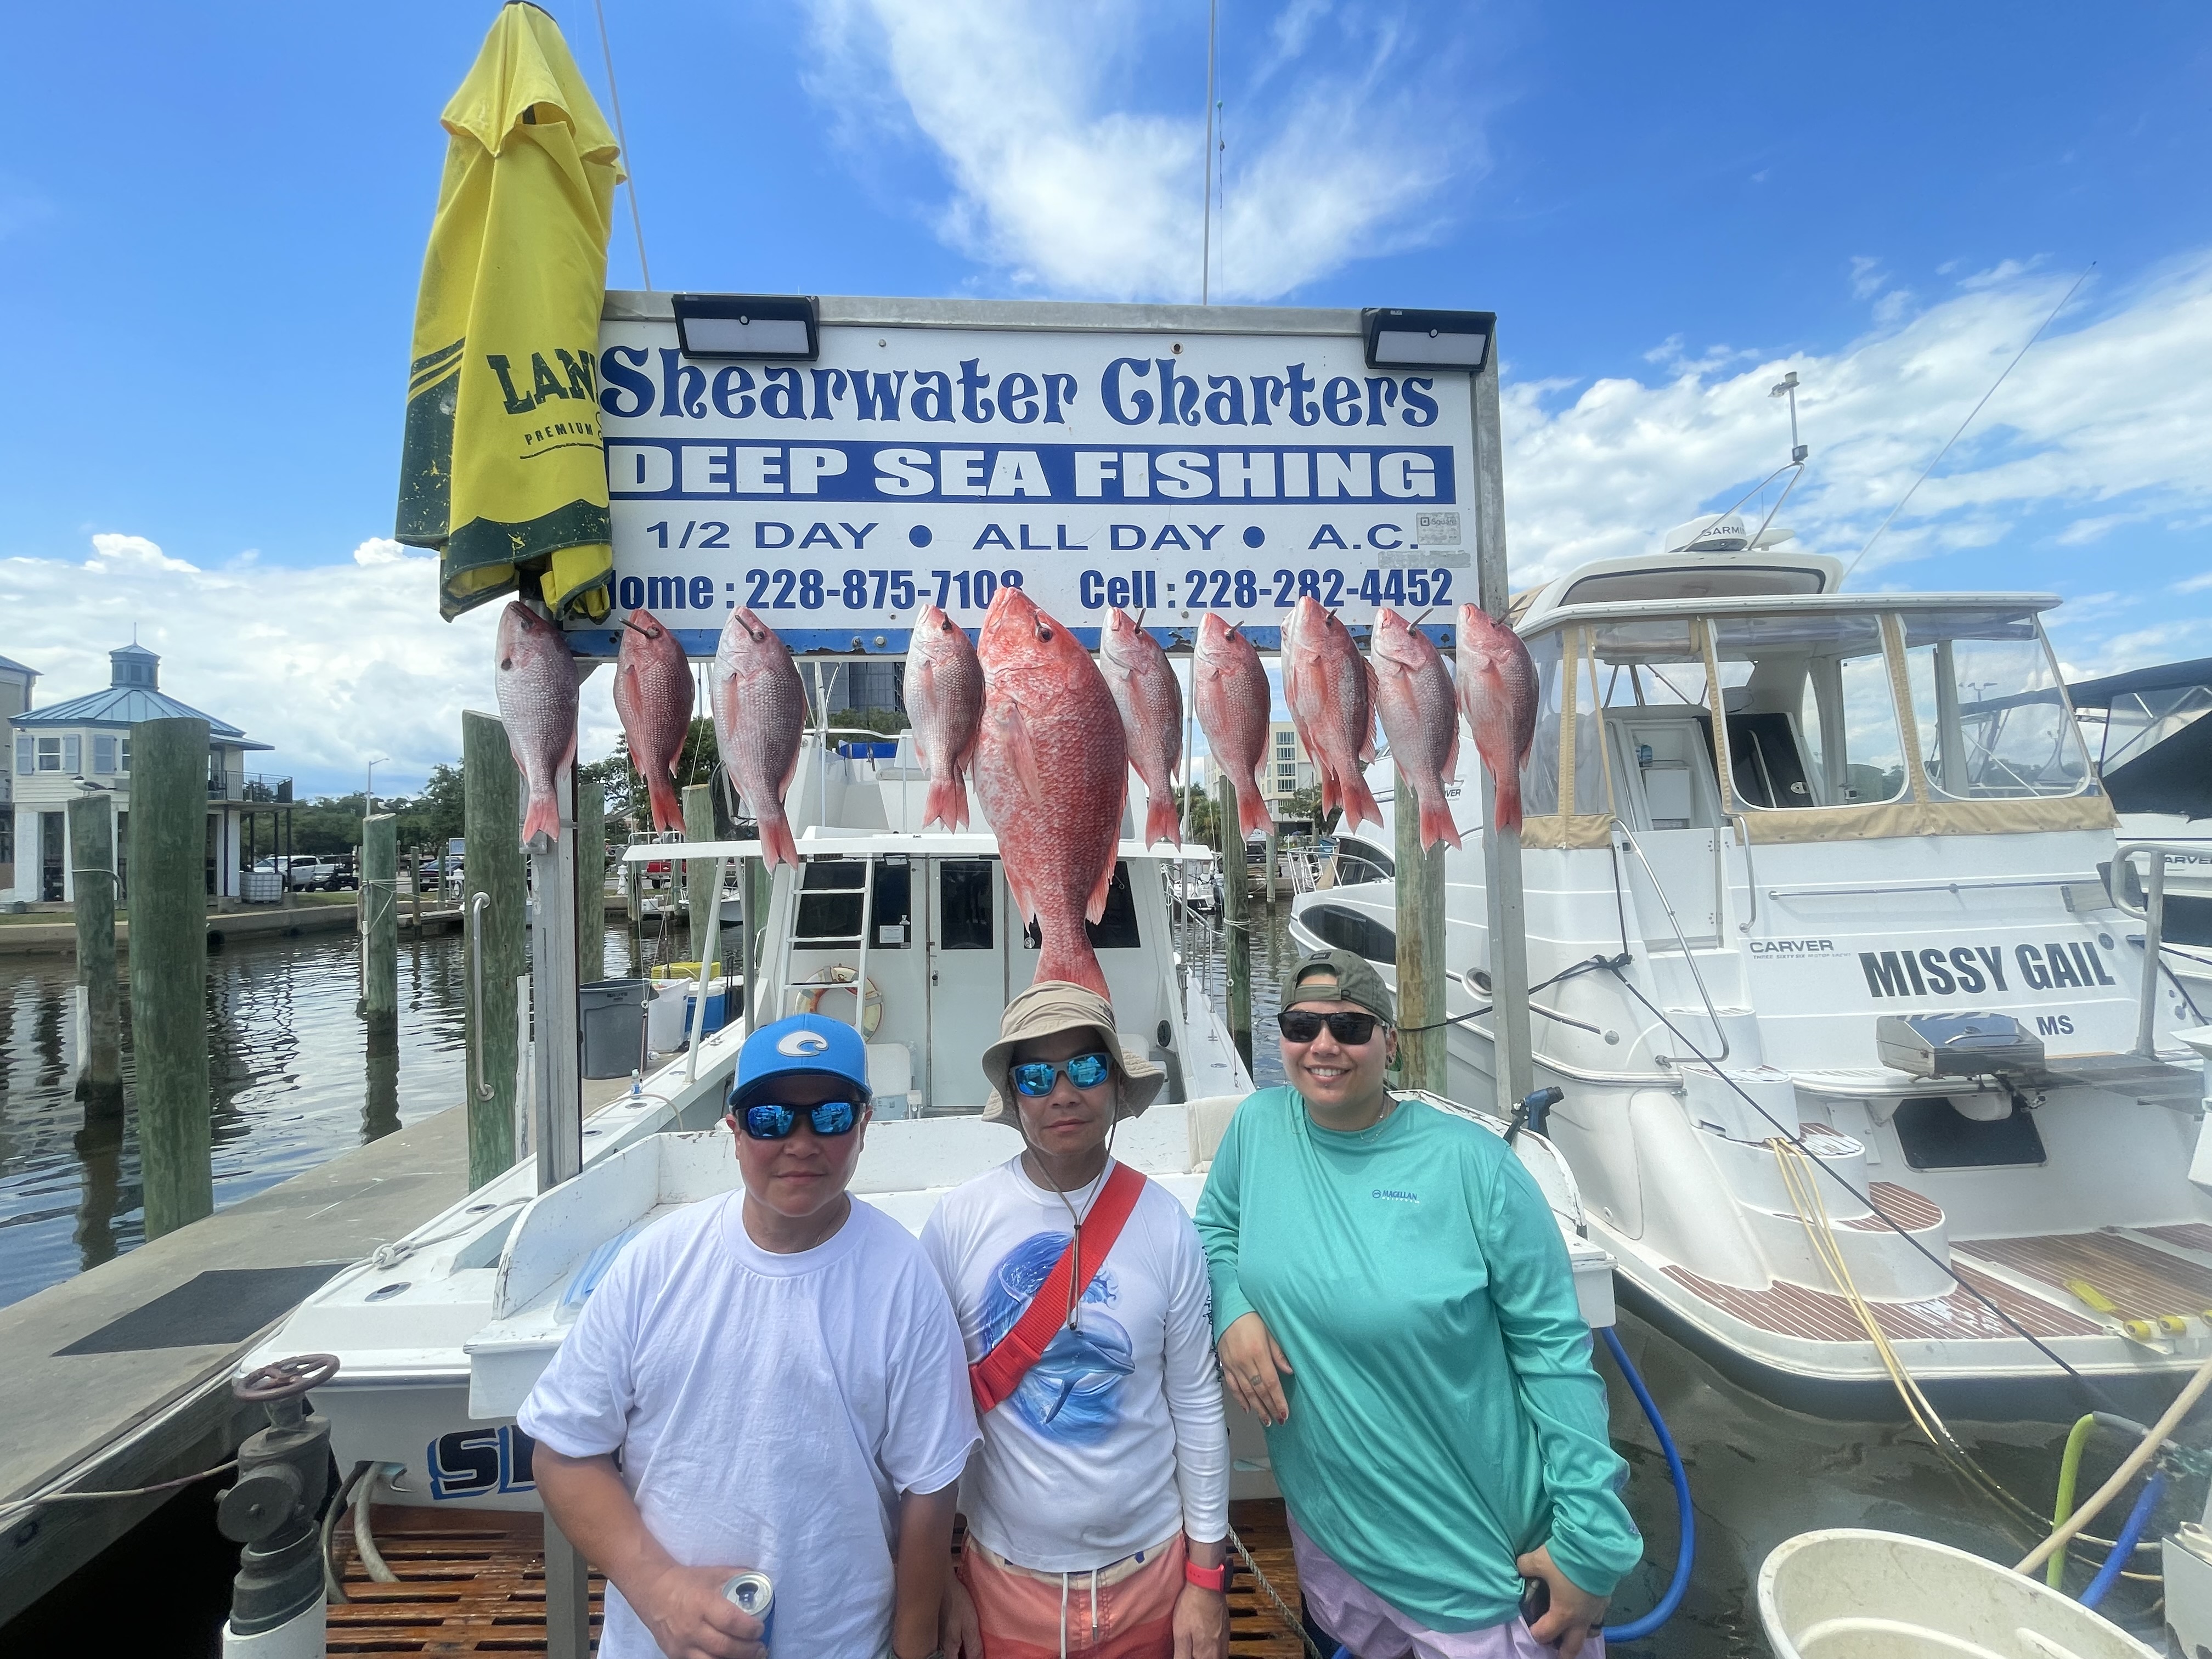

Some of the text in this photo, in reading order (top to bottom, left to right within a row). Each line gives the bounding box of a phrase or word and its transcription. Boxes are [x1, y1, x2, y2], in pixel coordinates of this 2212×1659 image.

[486, 348, 599, 415] LAN
[601, 346, 1440, 427] Shearwater Charters
[524, 422, 594, 445] PREMIUM
[608, 445, 1436, 498] DEEP SEA FISHING
[647, 521, 730, 549] 1/2
[755, 522, 879, 550] DAY
[972, 523, 1088, 550] ALL
[1110, 524, 1225, 550] DAY
[1308, 523, 1419, 550] A.C.
[1185, 568, 1453, 609] 228-282-4452
[1750, 940, 1834, 953] CARVER
[1859, 941, 2116, 998] MISSY GAIL
[2036, 1015, 2074, 1036] MS
[1383, 1190, 1417, 1200] MAGELLAN
